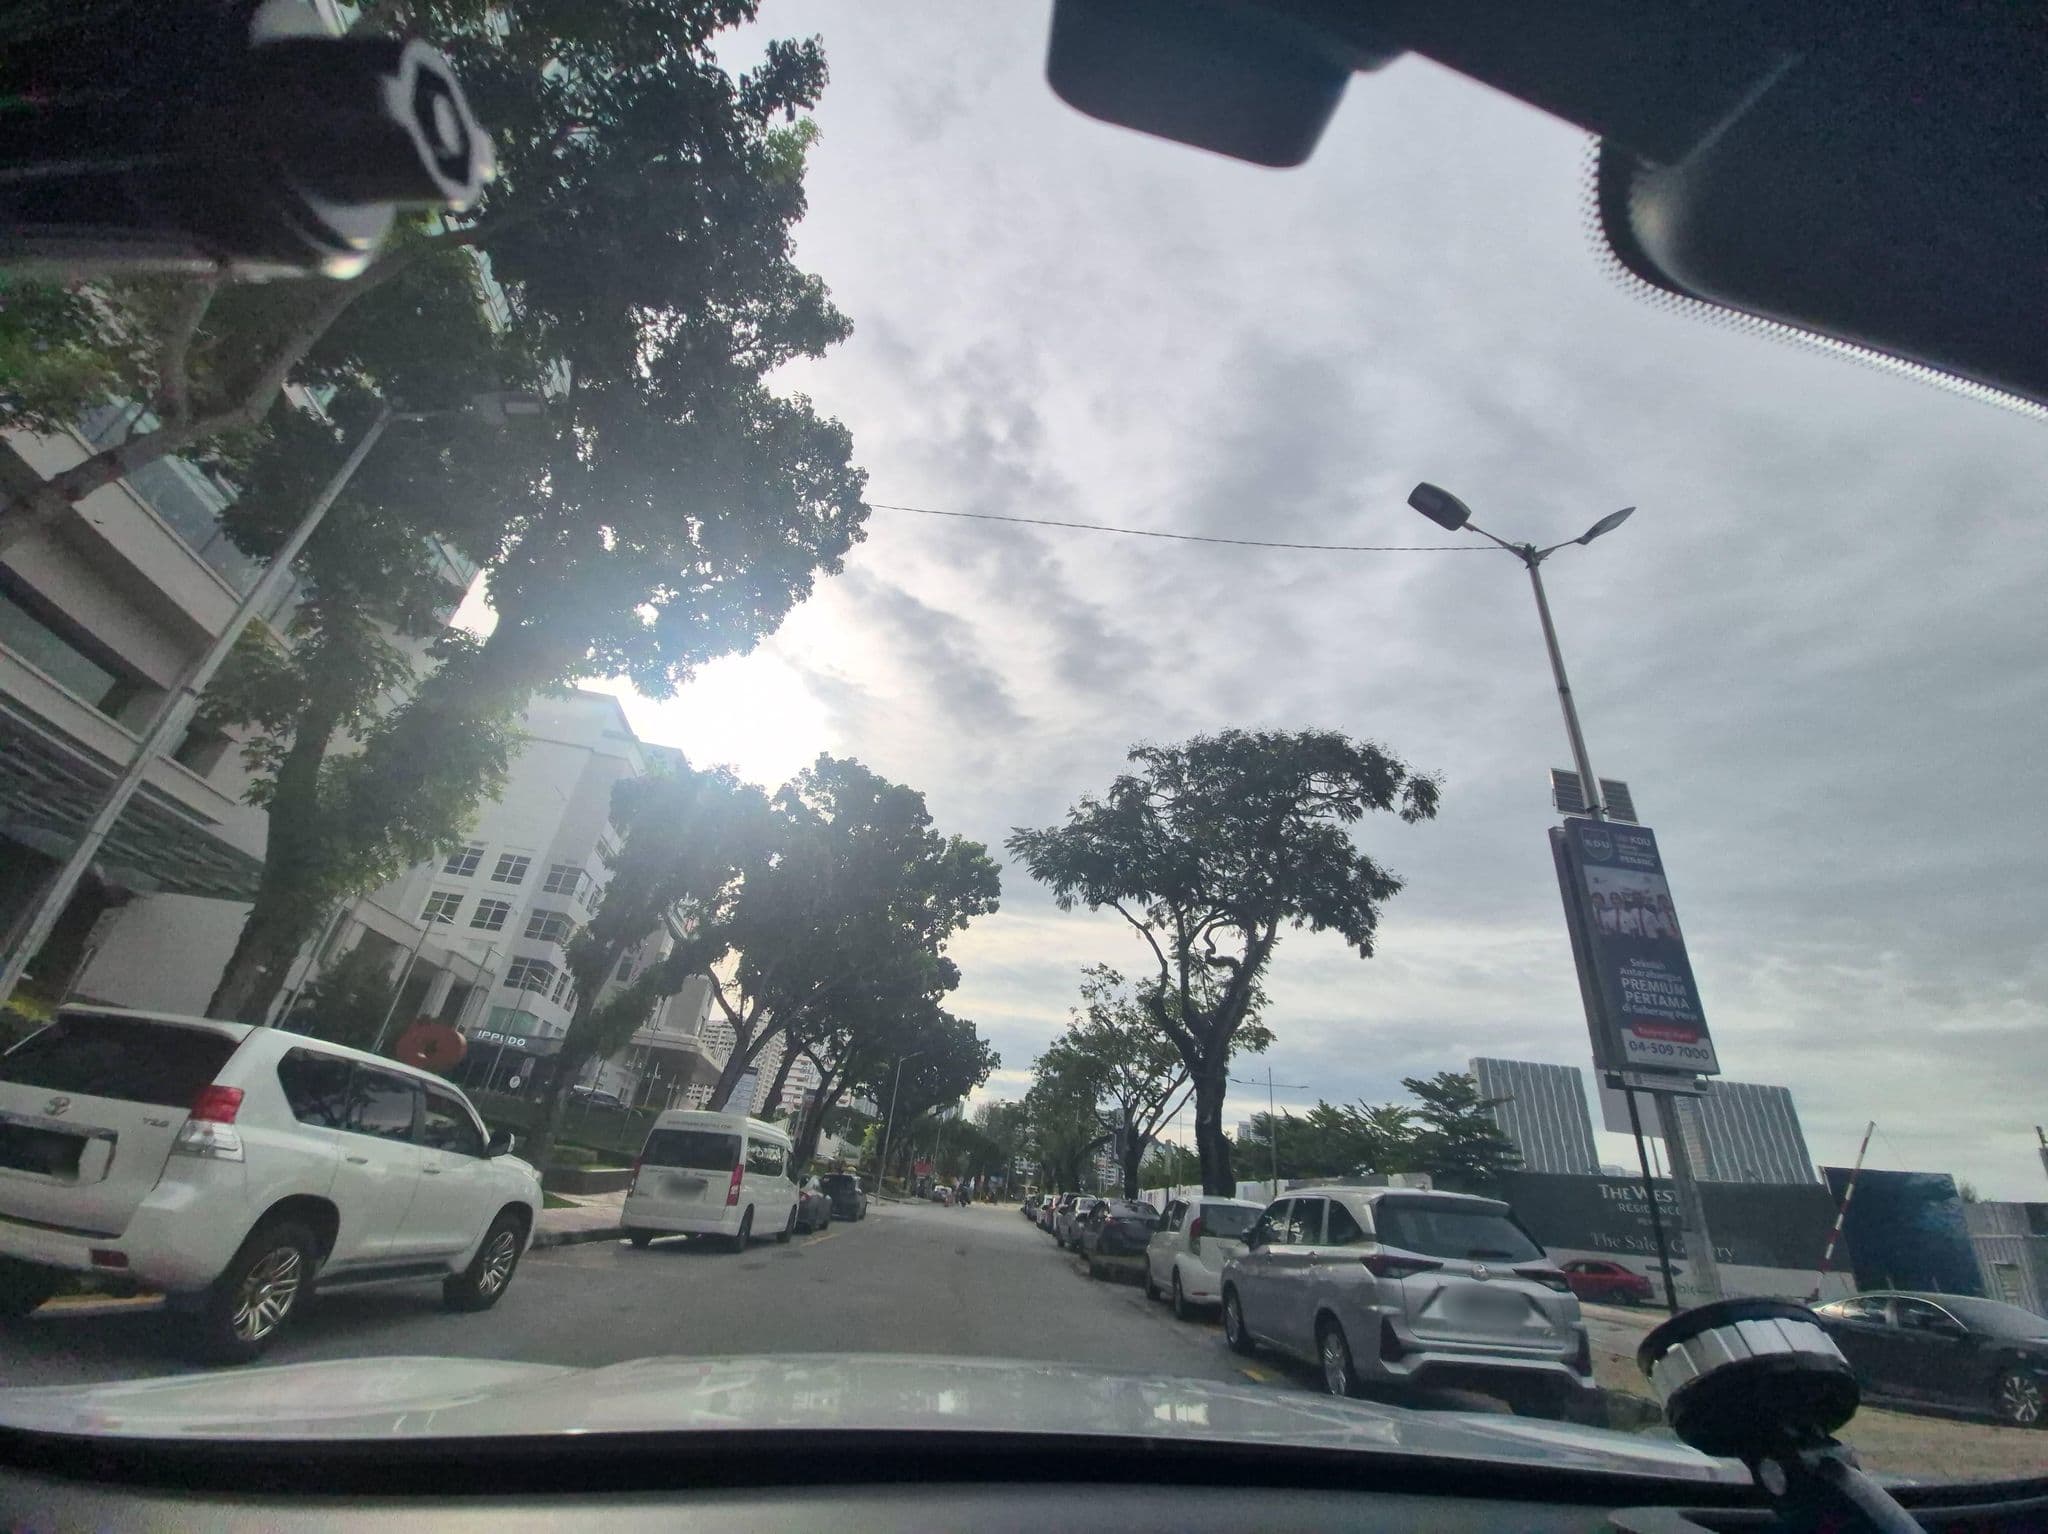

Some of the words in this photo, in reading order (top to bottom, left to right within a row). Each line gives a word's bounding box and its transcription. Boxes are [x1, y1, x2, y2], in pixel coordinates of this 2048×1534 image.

[1621, 977, 1687, 997] PREMIUM
[1625, 991, 1689, 1009] PERTAMA
[478, 1030, 526, 1047] IPPUDO
[1628, 1041, 1674, 1056] 04-509
[1677, 1045, 1710, 1060] 7000
[1617, 1203, 1681, 1216] RESIDNC
[1590, 1232, 1622, 1248] The
[1625, 1235, 1659, 1251] Sale
